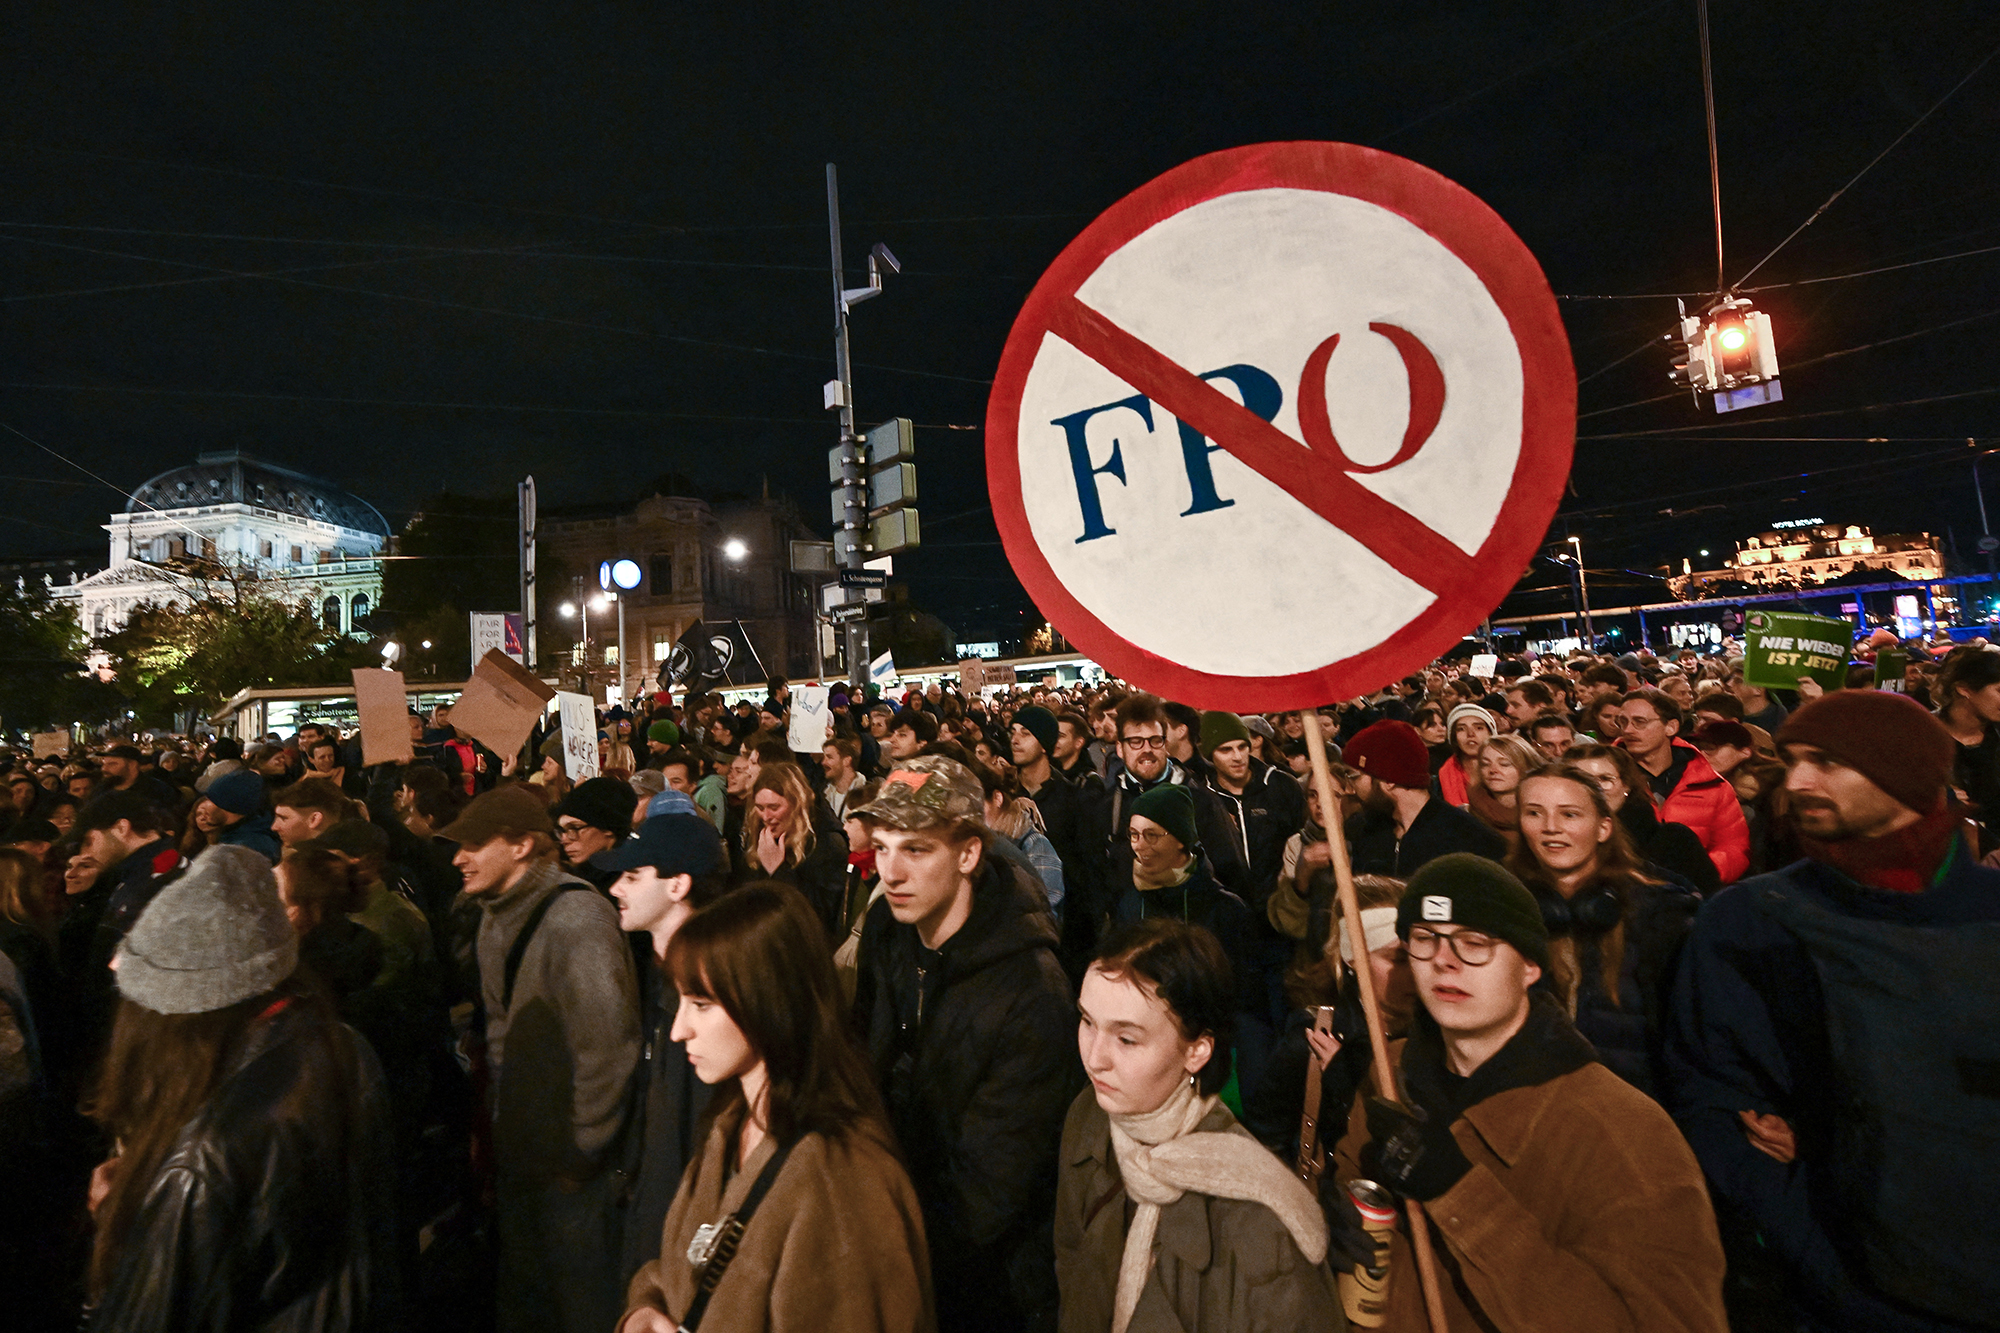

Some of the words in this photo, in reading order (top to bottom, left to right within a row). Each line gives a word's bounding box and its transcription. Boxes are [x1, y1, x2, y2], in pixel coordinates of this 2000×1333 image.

[479, 619, 500, 628] FAIR
[479, 630, 500, 638] FOR
[1759, 636, 1794, 650] NIE
[1797, 638, 1845, 658] WIEDER
[1767, 652, 1801, 666] IST
[1803, 655, 1839, 671] JETZT
